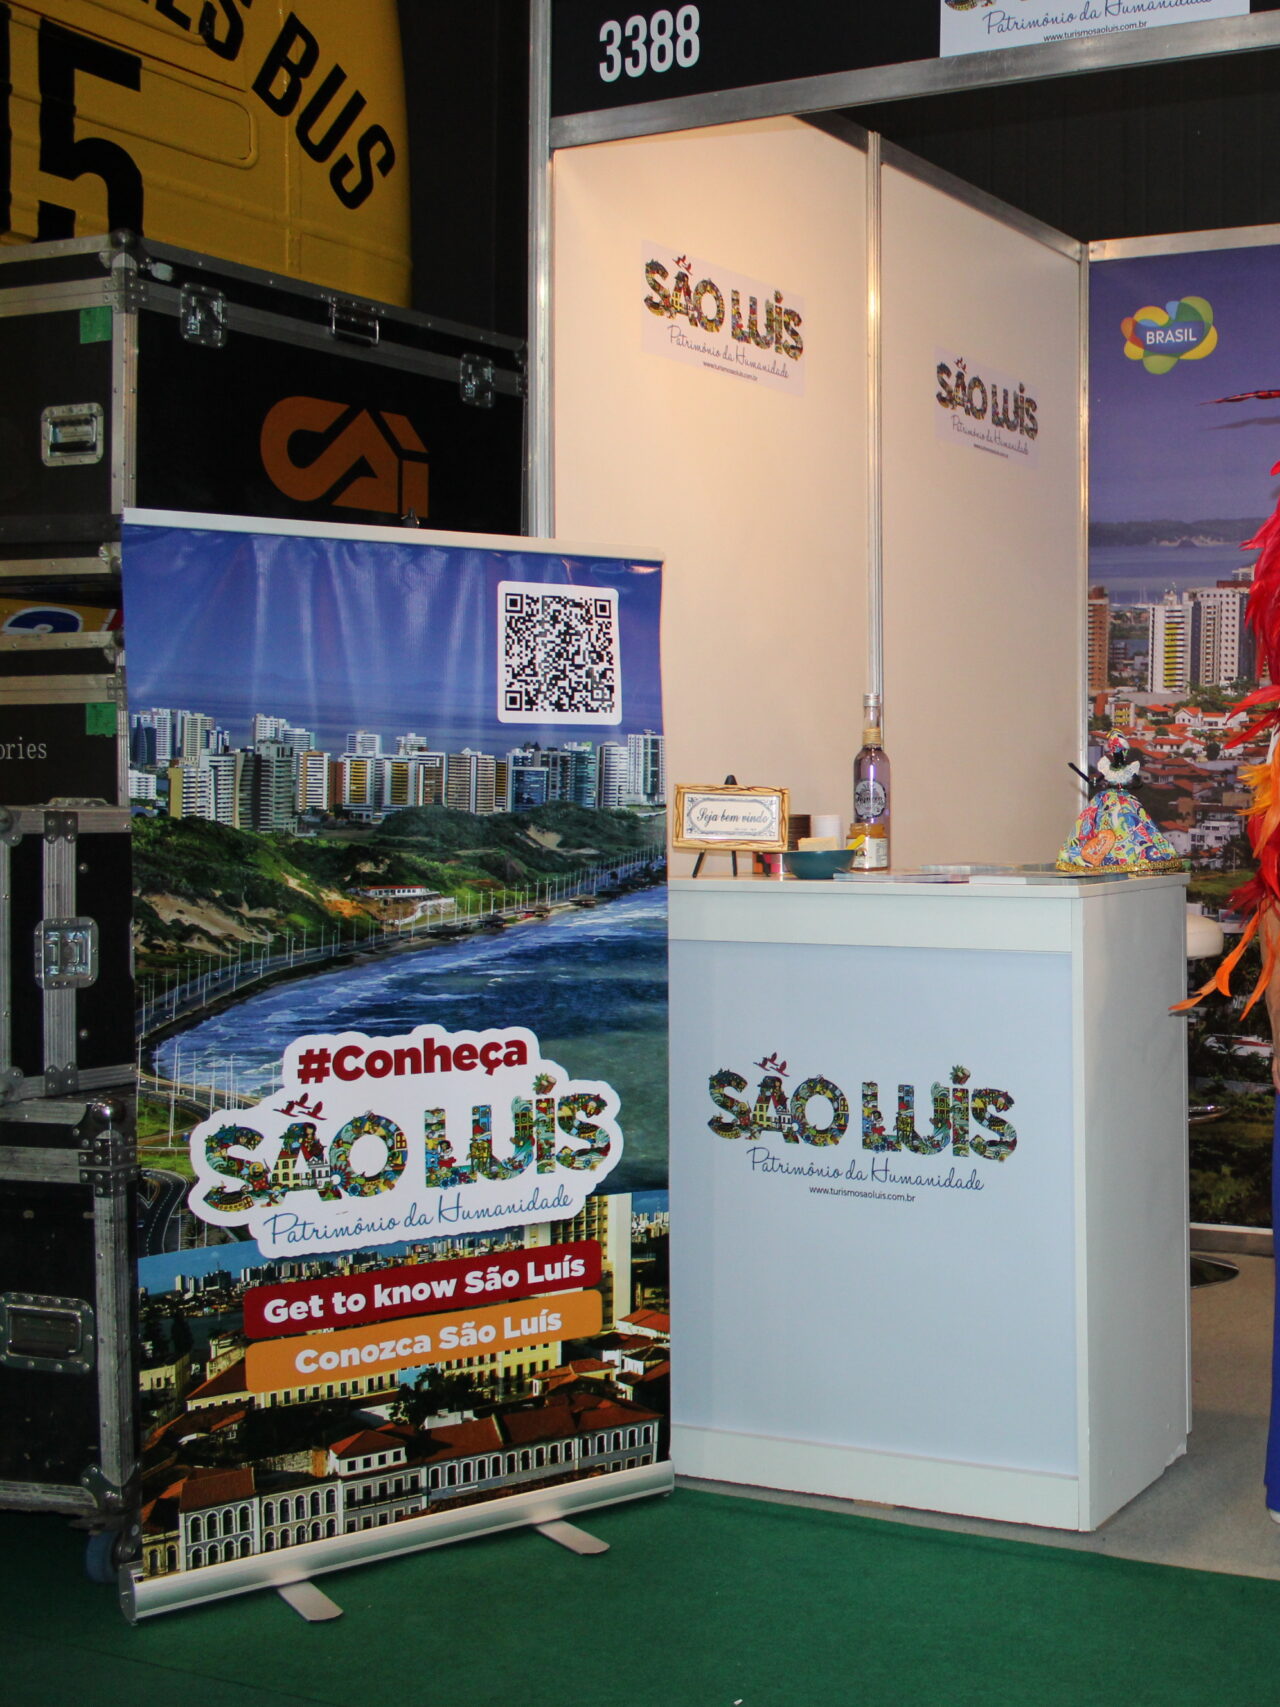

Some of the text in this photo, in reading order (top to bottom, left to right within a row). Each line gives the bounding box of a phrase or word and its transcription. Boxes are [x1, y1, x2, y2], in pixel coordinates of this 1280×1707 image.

[599, 4, 700, 83] 3388
[982, 9, 1077, 35] Patrimônio
[1079, 1, 1102, 21] da
[1043, 20, 1147, 42] www.turismosaoluis.com.br
[251, 12, 396, 210] BUS
[1146, 328, 1198, 345] BRASIL
[296, 1037, 528, 1085] #Conheça
[707, 1051, 850, 1148] SÃO
[203, 1092, 409, 1213] SÃO
[746, 1146, 985, 1191] Patrimônio da Humanidade
[263, 1184, 574, 1246] Patrimônio da Humanidade
[809, 1186, 916, 1203] www.turismosaoluis.com.br
[263, 1254, 586, 1324] Get to know São Luís
[294, 1309, 563, 1375] Conozca São Luís
